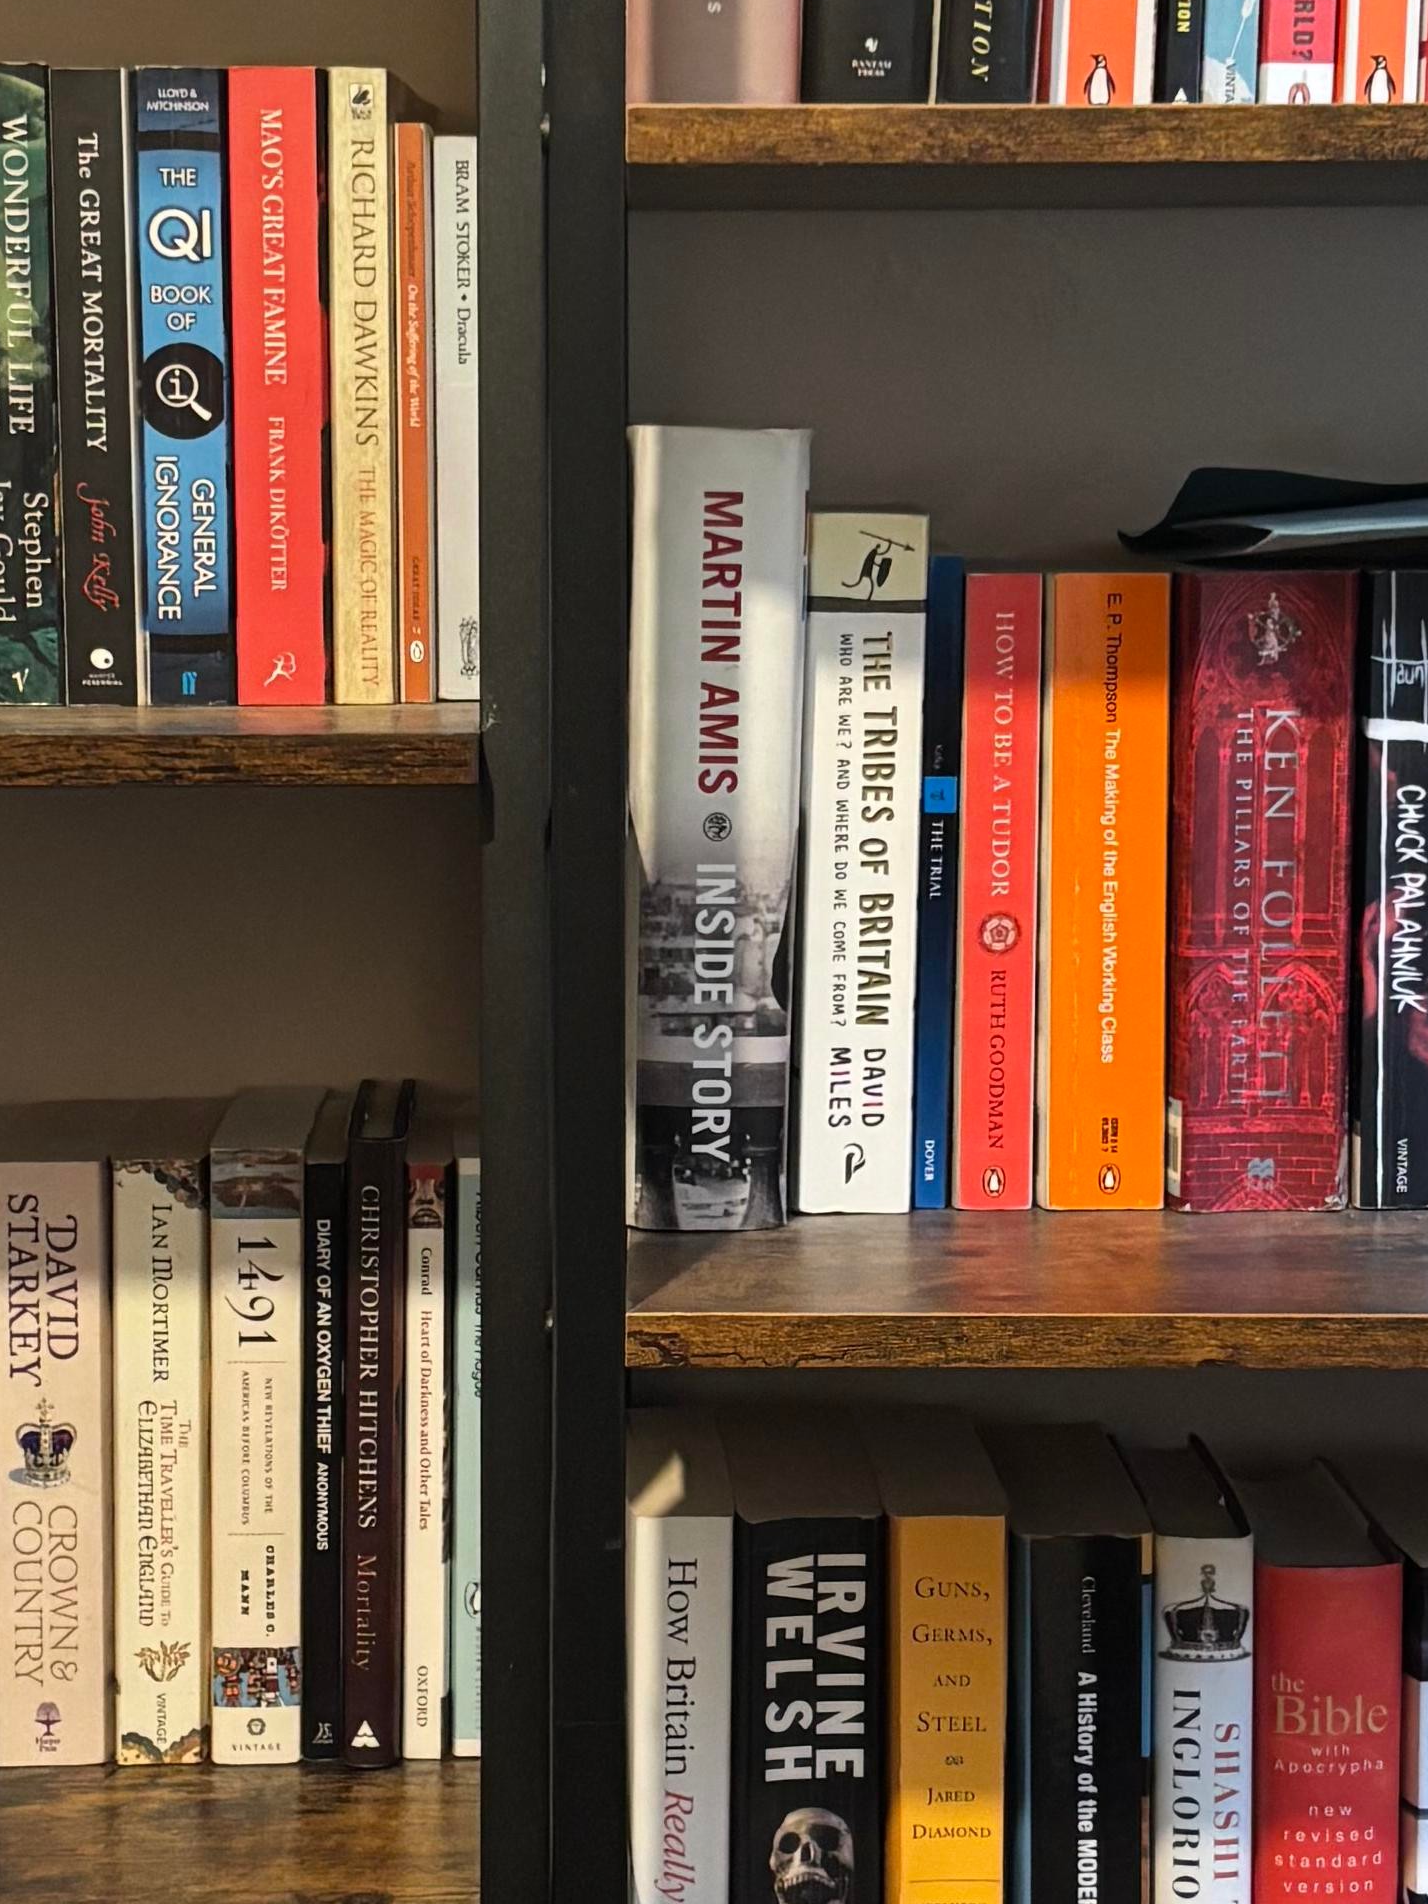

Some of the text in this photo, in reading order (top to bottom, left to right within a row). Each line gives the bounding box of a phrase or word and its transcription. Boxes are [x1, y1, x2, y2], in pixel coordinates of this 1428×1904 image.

[454, 160, 472, 364] BRAM STOKER Dracula
[23, 493, 48, 609] Stephen
[155, 456, 181, 620] IGNORANCE
[191, 479, 217, 597] GENERAL
[698, 490, 744, 796] MARTIN AMIS
[690, 862, 737, 1165] INSIDE STORY
[988, 969, 1008, 1149] RUTH GOODMAN
[829, 1046, 850, 1129] MILES
[863, 1046, 885, 1128] DAVID
[8, 1193, 42, 1388] STARKEY
[46, 1214, 79, 1361] DAVID
[225, 1236, 286, 1348] 1491
[1271, 1674, 1304, 1694] the
[1276, 1694, 1388, 1736] Bible
[1273, 1759, 1384, 1775] Apocrypha
[1312, 1745, 1349, 1757] with
